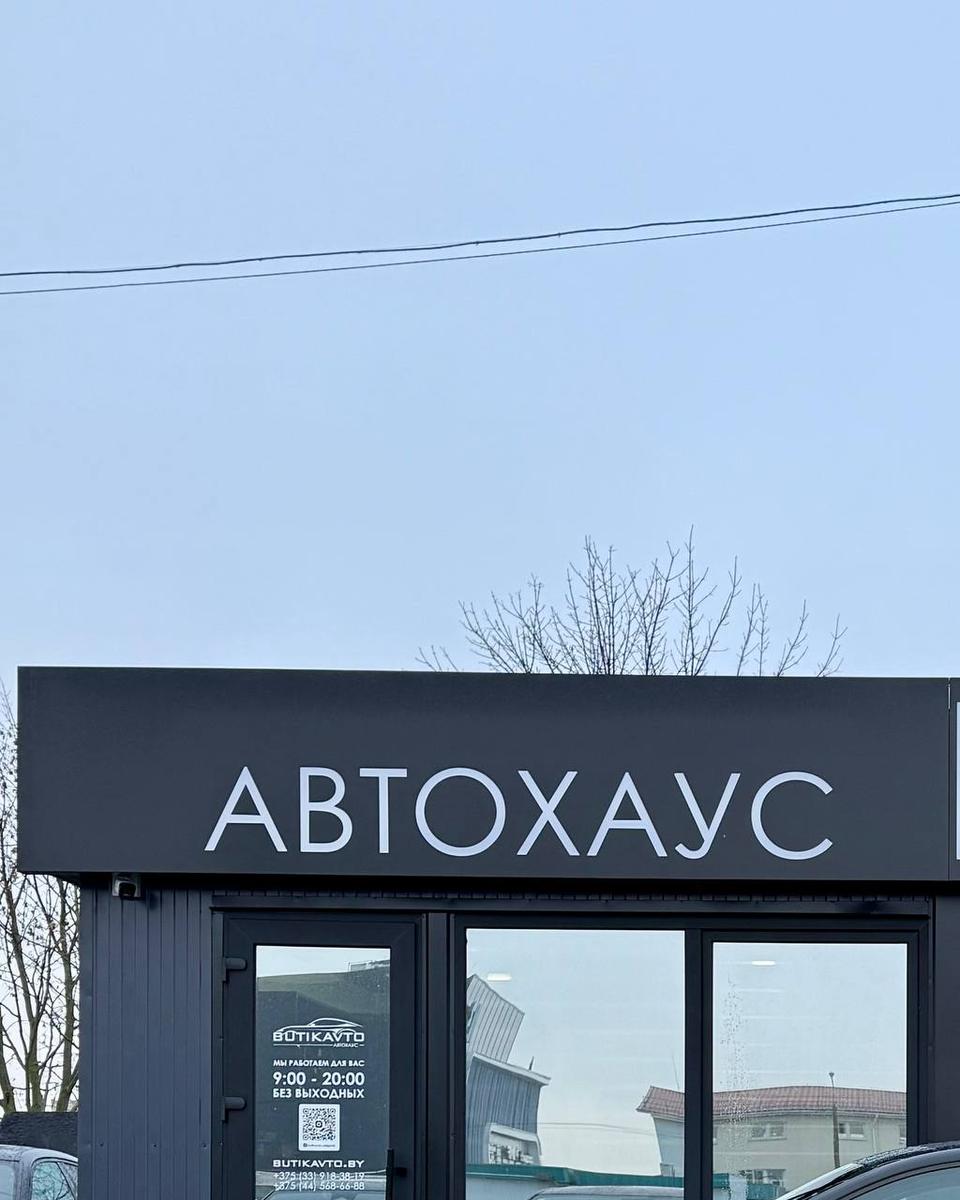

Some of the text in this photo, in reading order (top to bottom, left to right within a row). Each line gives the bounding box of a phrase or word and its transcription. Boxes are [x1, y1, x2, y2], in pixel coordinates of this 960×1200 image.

[204, 766, 833, 860] АВТОХАУС
[273, 1032, 365, 1042] BUTIKAVTO
[331, 1060, 347, 1068] ДЛЯ
[273, 1072, 306, 1086] 9:00
[322, 1072, 365, 1086] 20:00
[273, 1089, 365, 1099] БЕЗ ВЫХОДНЫХ
[273, 1159, 365, 1168] BUTIKAVTO.BY
[273, 1171, 365, 1182] +375 (33) 918-38-19
[274, 1181, 365, 1191] +375 (44) 568-66-88
